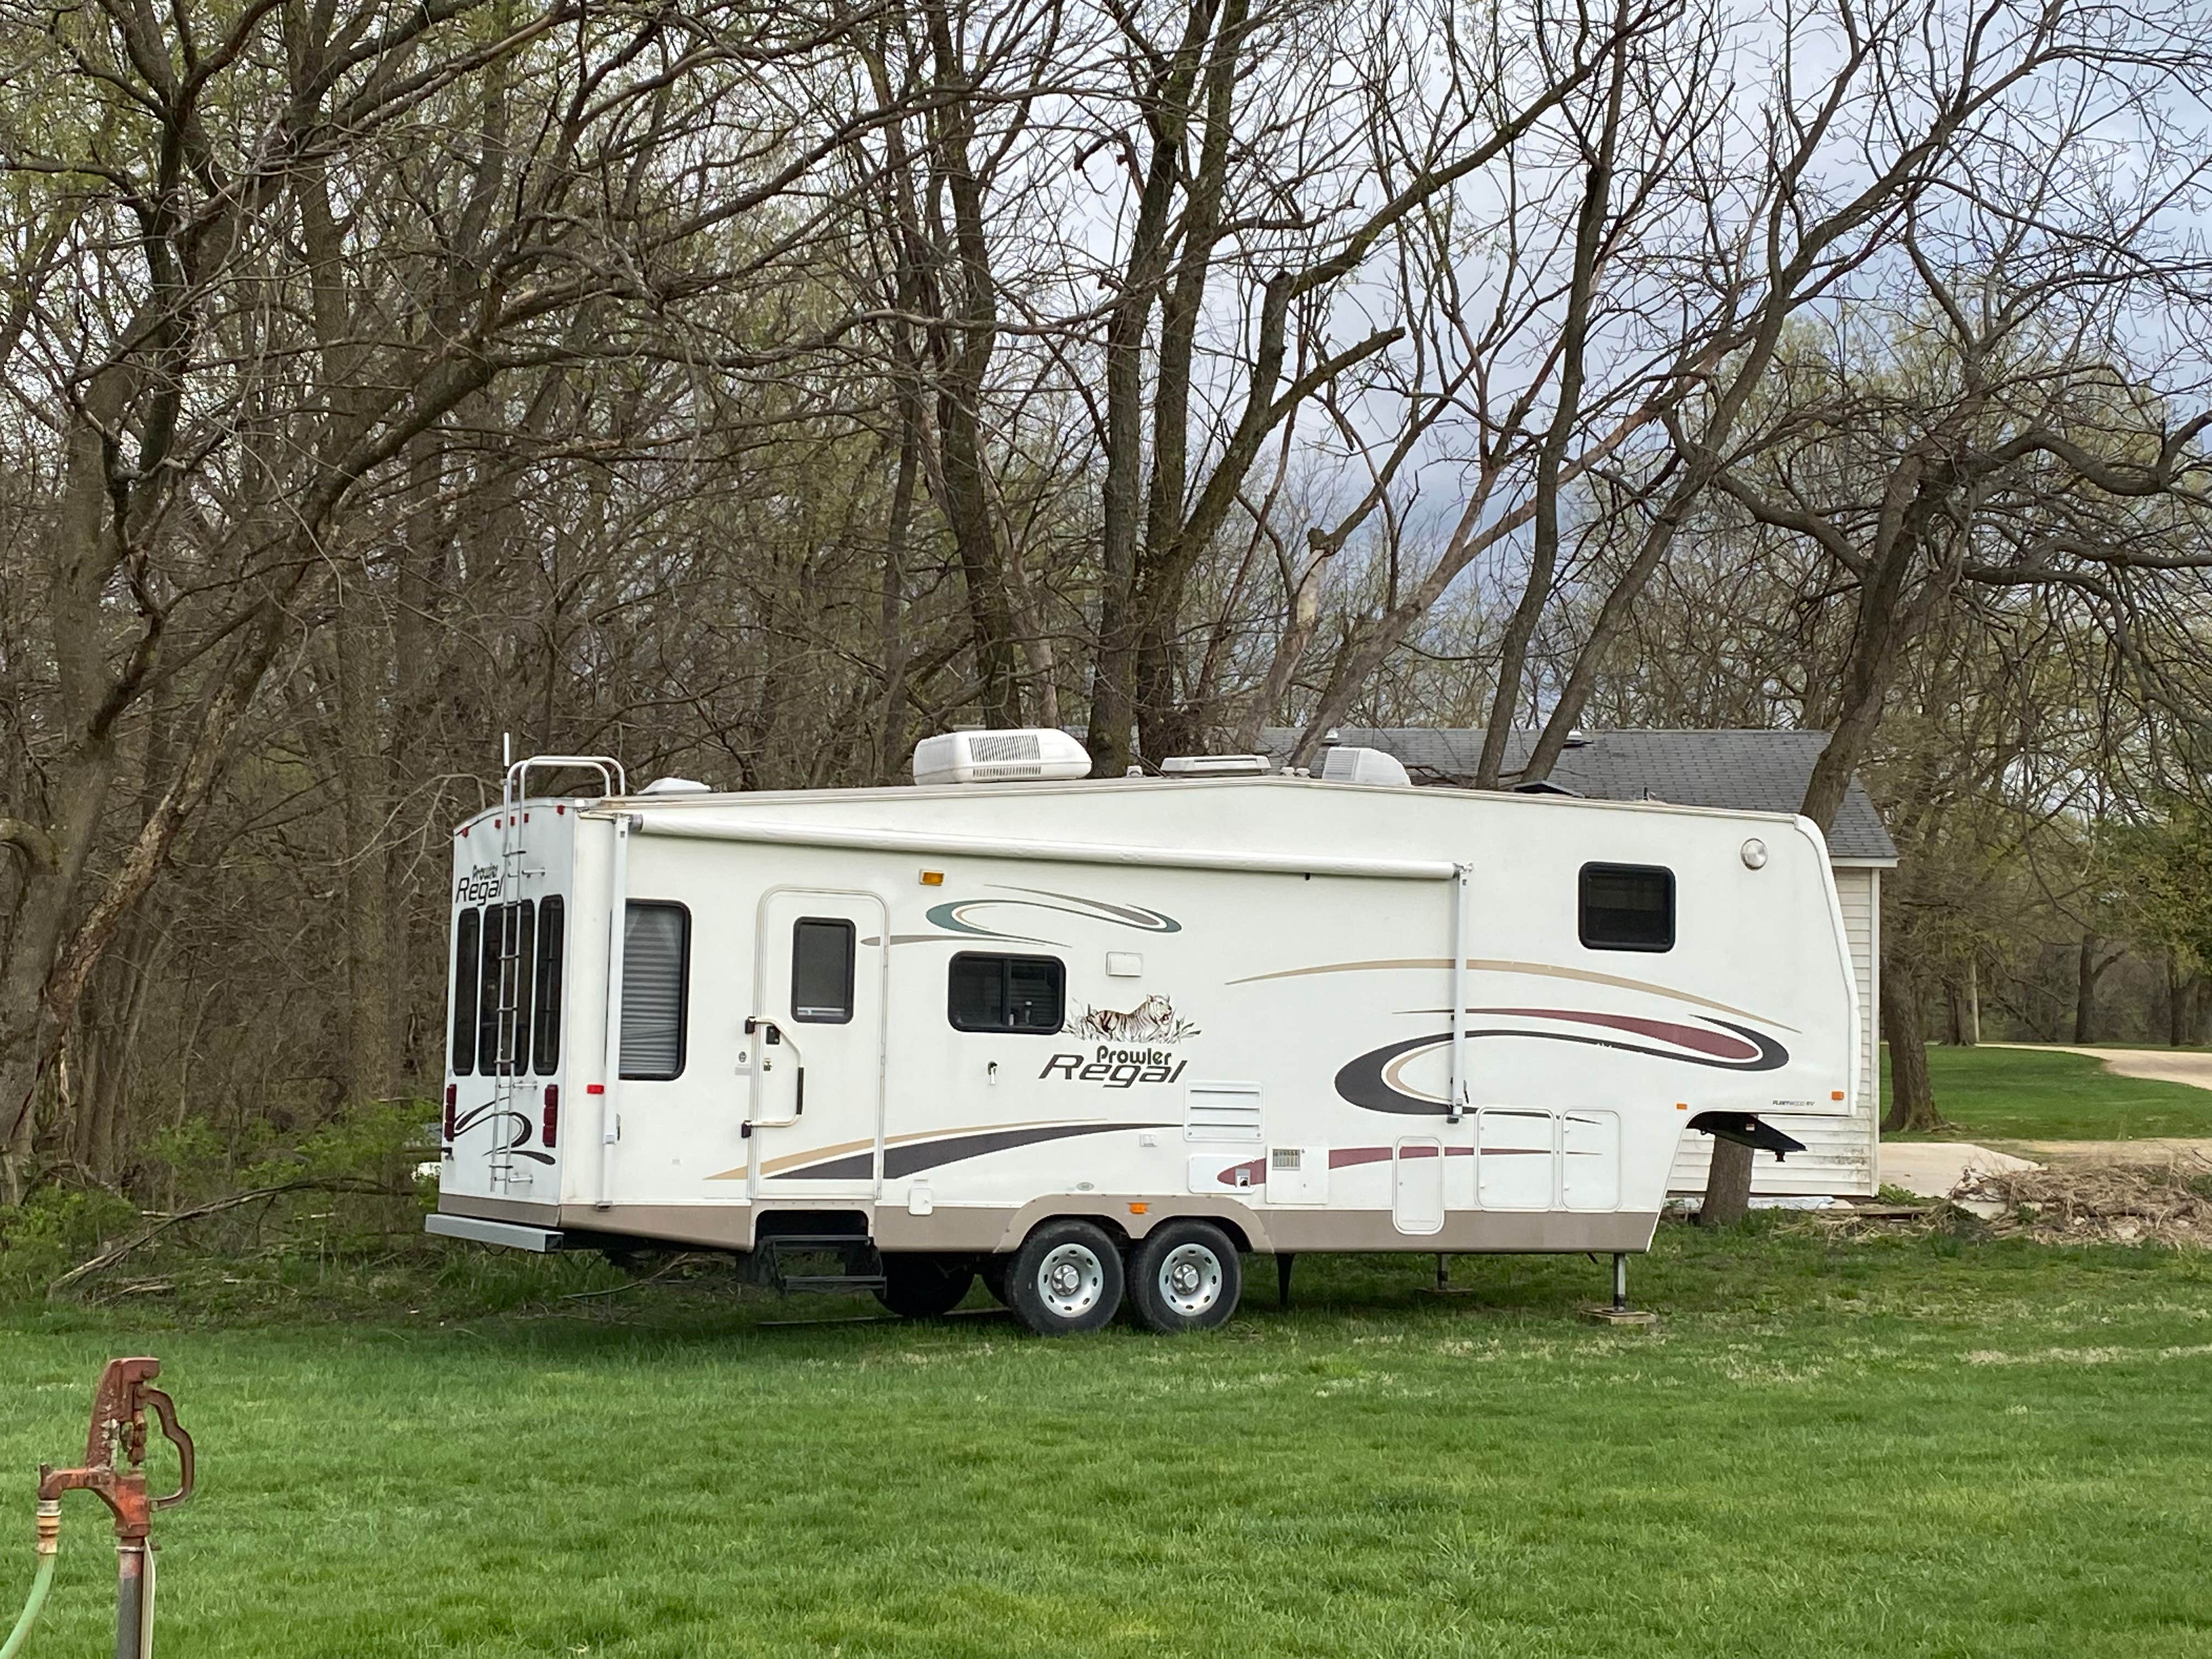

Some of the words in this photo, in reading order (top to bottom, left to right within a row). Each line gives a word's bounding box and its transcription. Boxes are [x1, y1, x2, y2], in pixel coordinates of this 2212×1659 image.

[455, 874, 504, 906] Regal
[1038, 1054, 1188, 1088] Regal
[1097, 1045, 1172, 1065] Prowler
